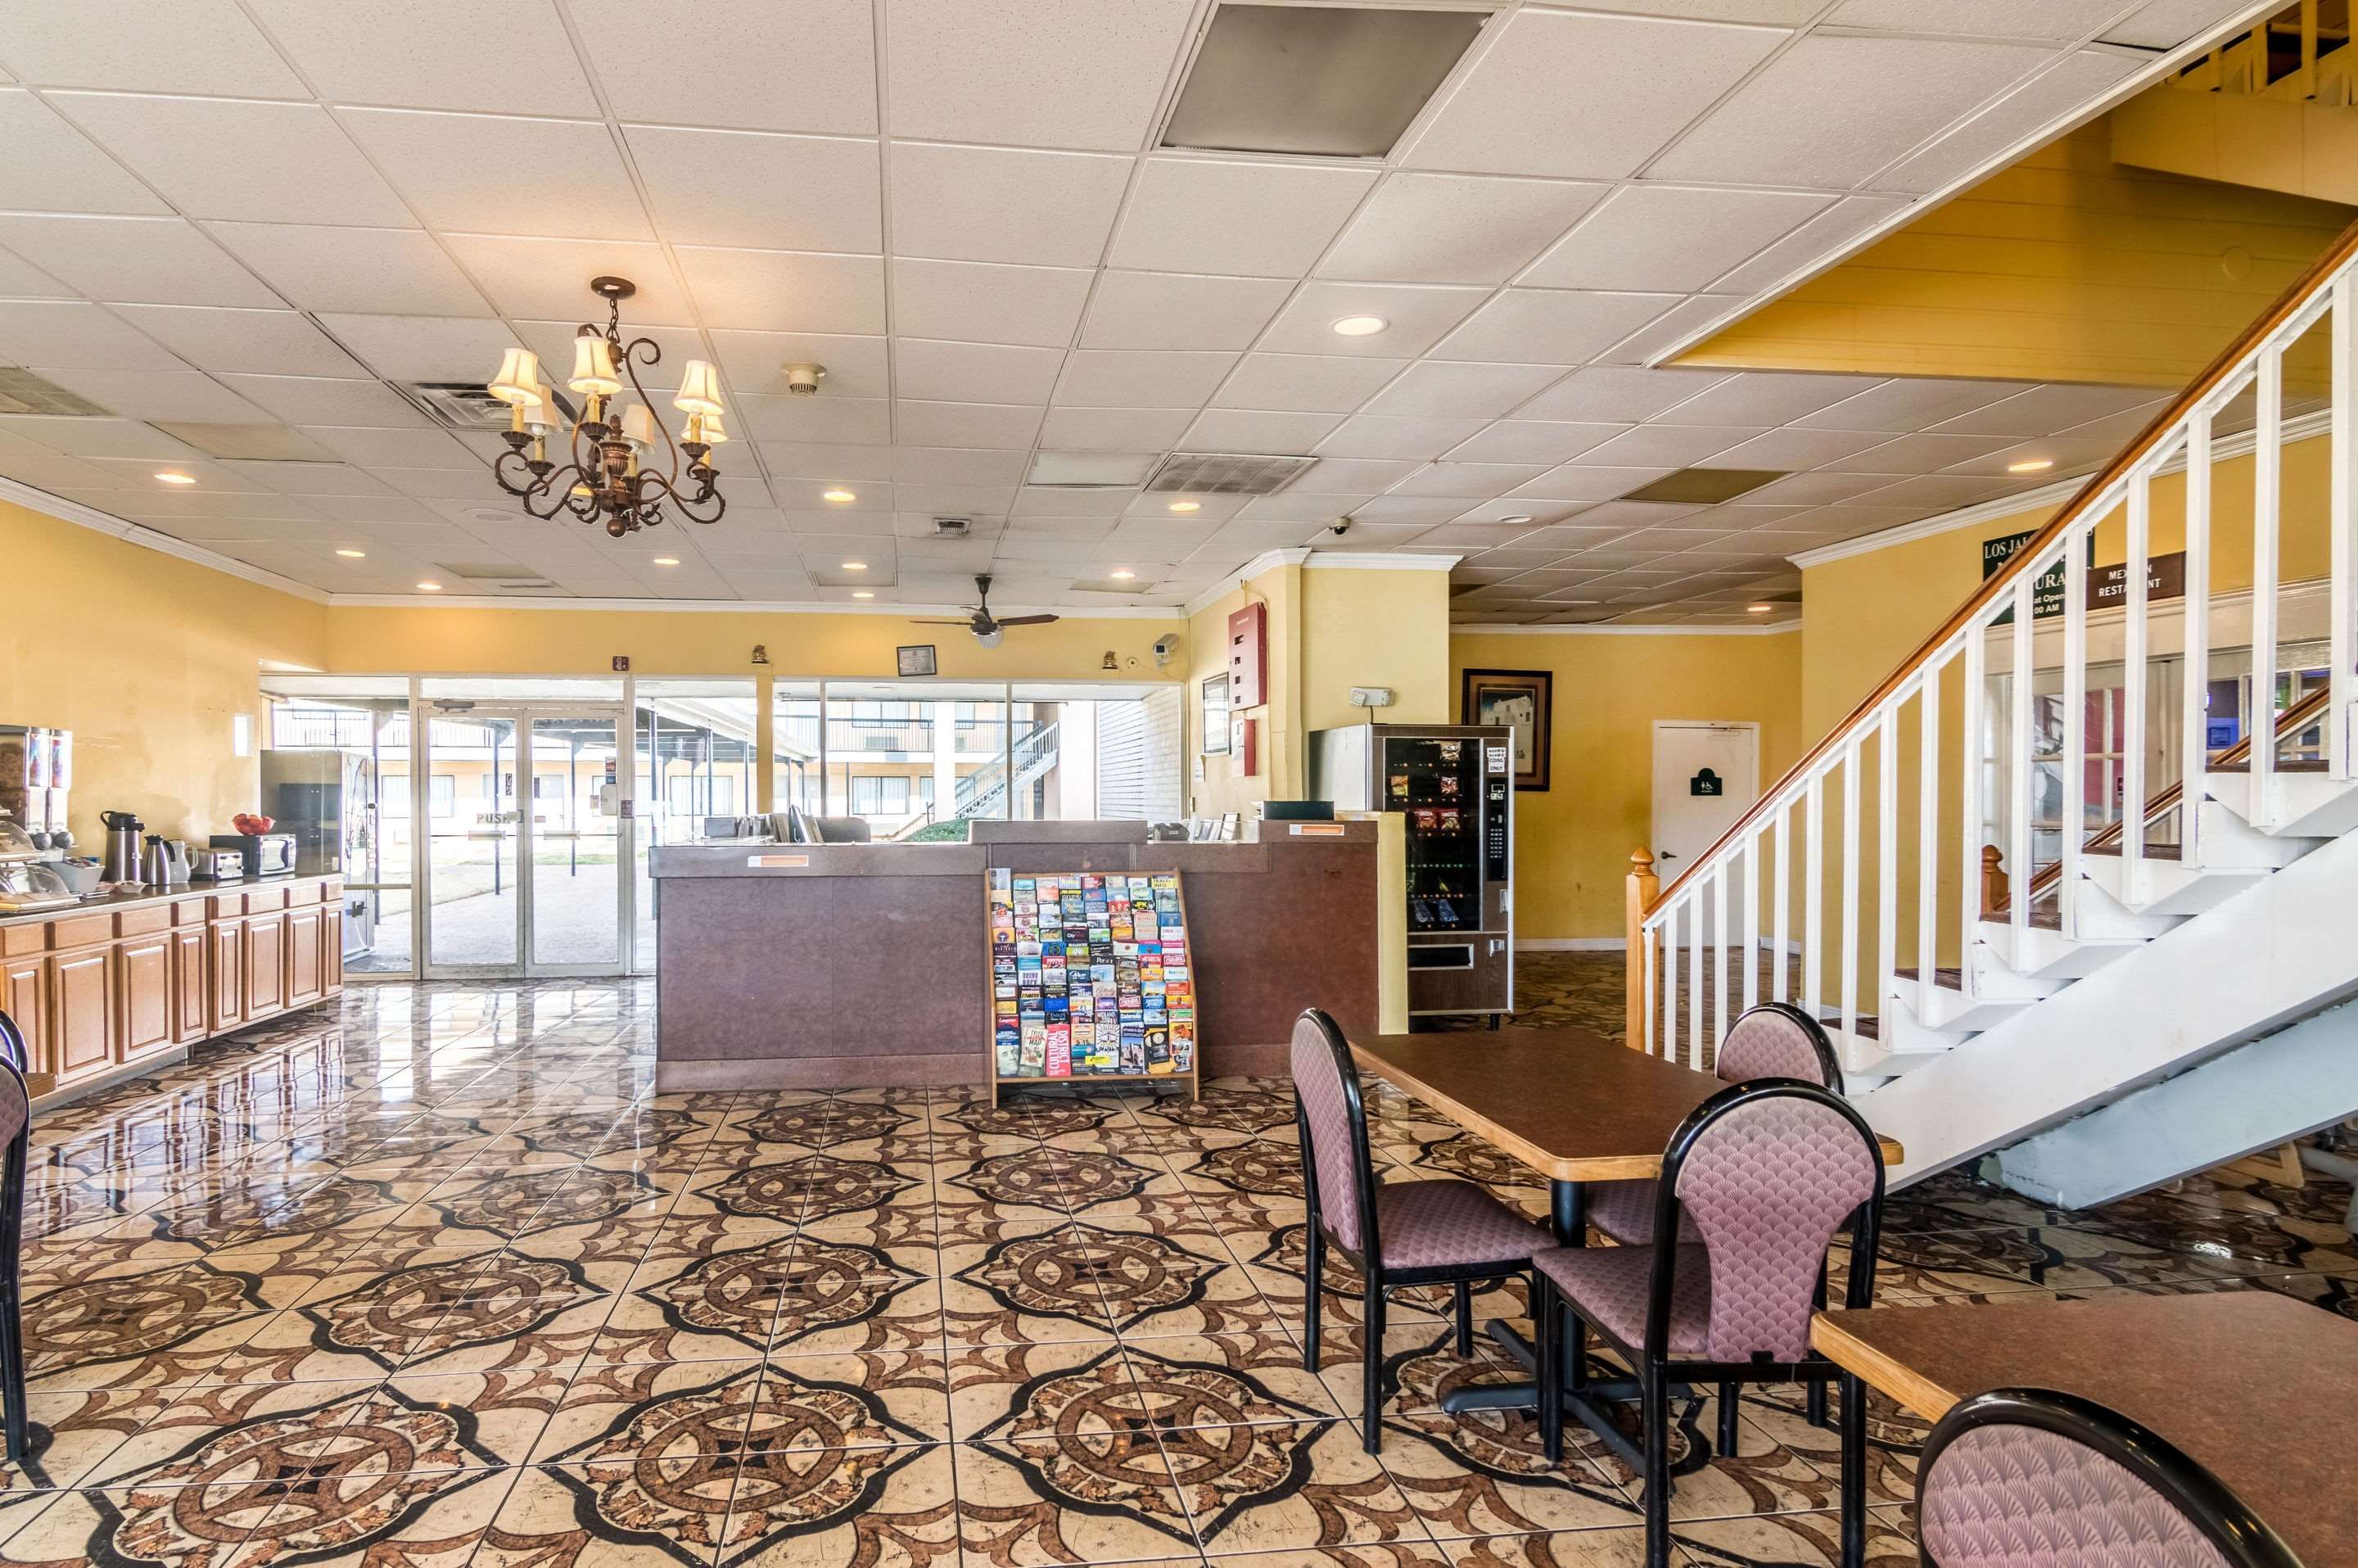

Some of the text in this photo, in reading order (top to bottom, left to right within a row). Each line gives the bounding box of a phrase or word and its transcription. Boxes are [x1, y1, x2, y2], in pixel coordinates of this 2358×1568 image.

[1985, 541, 2006, 558] LOS
[2109, 564, 2152, 580] MEXN
[2098, 578, 2162, 597] RESTANT
[2045, 603, 2059, 612] AM
[1048, 1031, 1059, 1069] CULTURAL
[1059, 1030, 1070, 1063] DISTRICT
